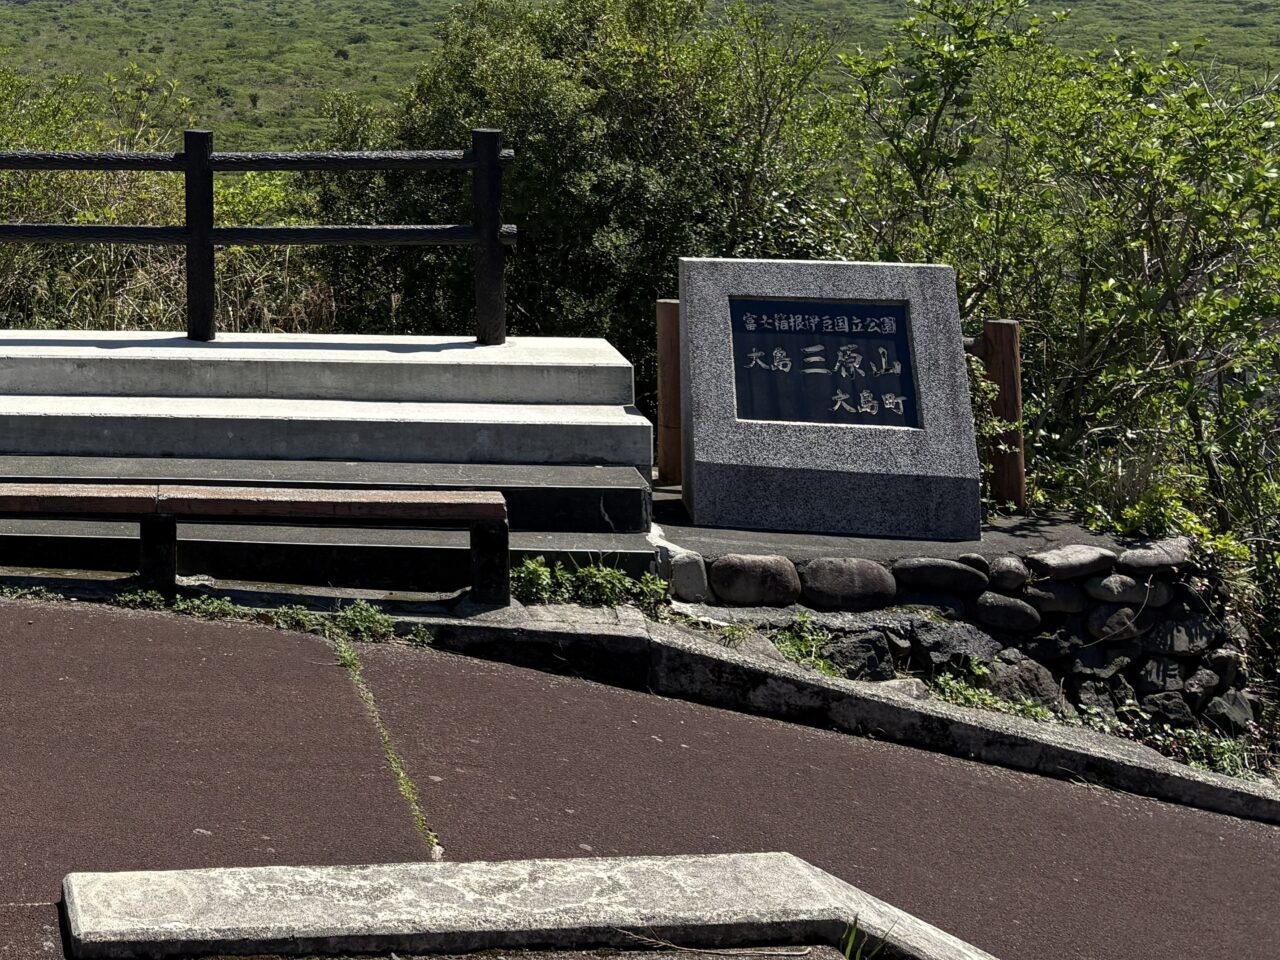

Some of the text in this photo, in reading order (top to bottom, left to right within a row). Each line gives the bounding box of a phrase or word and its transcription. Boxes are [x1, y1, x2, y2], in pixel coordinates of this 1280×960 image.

[742, 312, 897, 335] 富士箱根伊豆国立公園
[828, 388, 908, 415] 大島町
